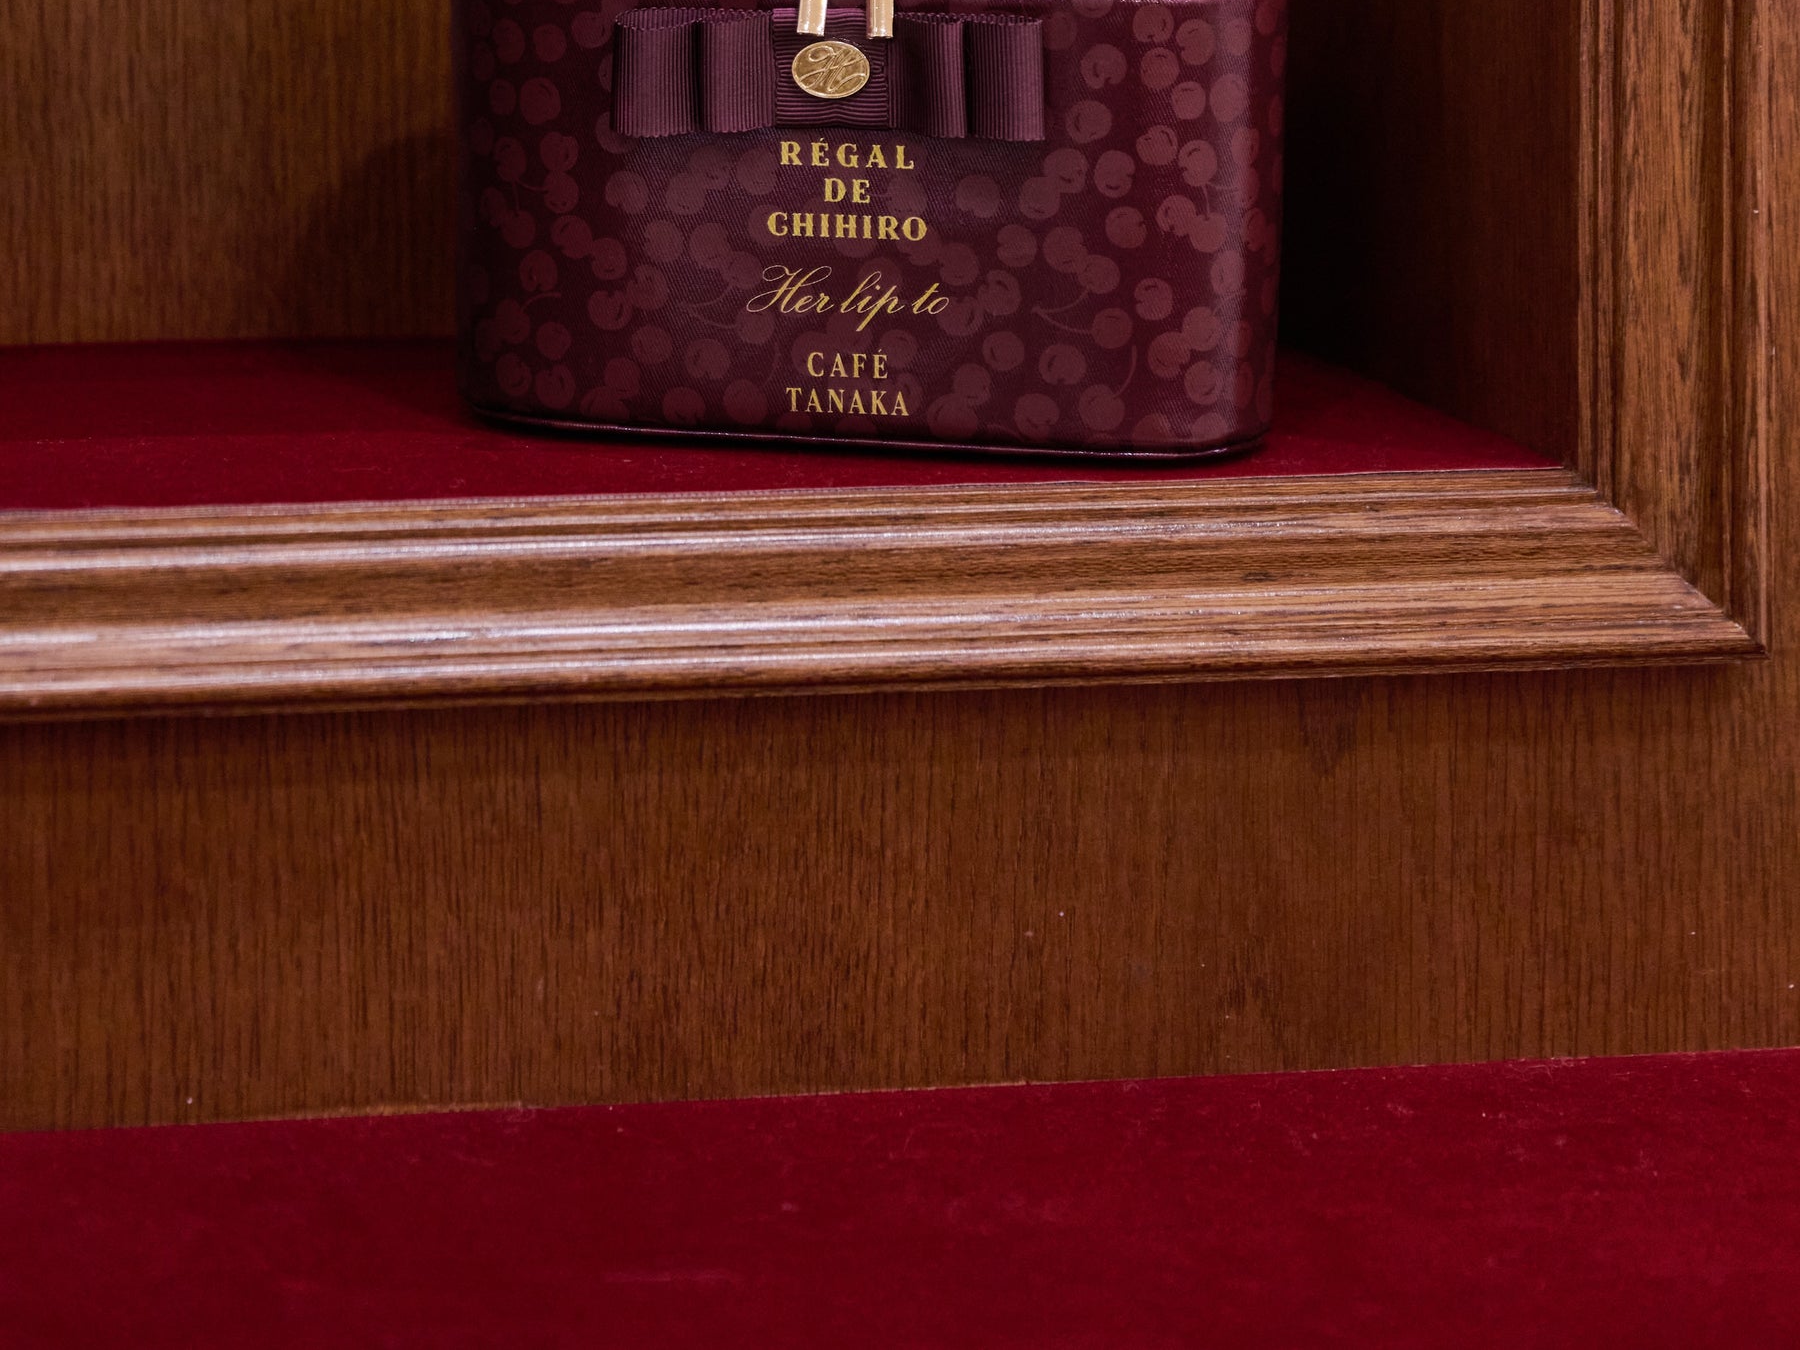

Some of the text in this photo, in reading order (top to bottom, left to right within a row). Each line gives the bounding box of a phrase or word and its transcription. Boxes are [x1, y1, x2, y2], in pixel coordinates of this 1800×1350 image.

[779, 137, 915, 170] RÉGAL
[824, 177, 871, 204] DE
[767, 211, 928, 242] CHIHIRO
[746, 264, 950, 332] Her lip to
[806, 349, 888, 380] CAFÉ
[785, 387, 910, 417] TANAKA
